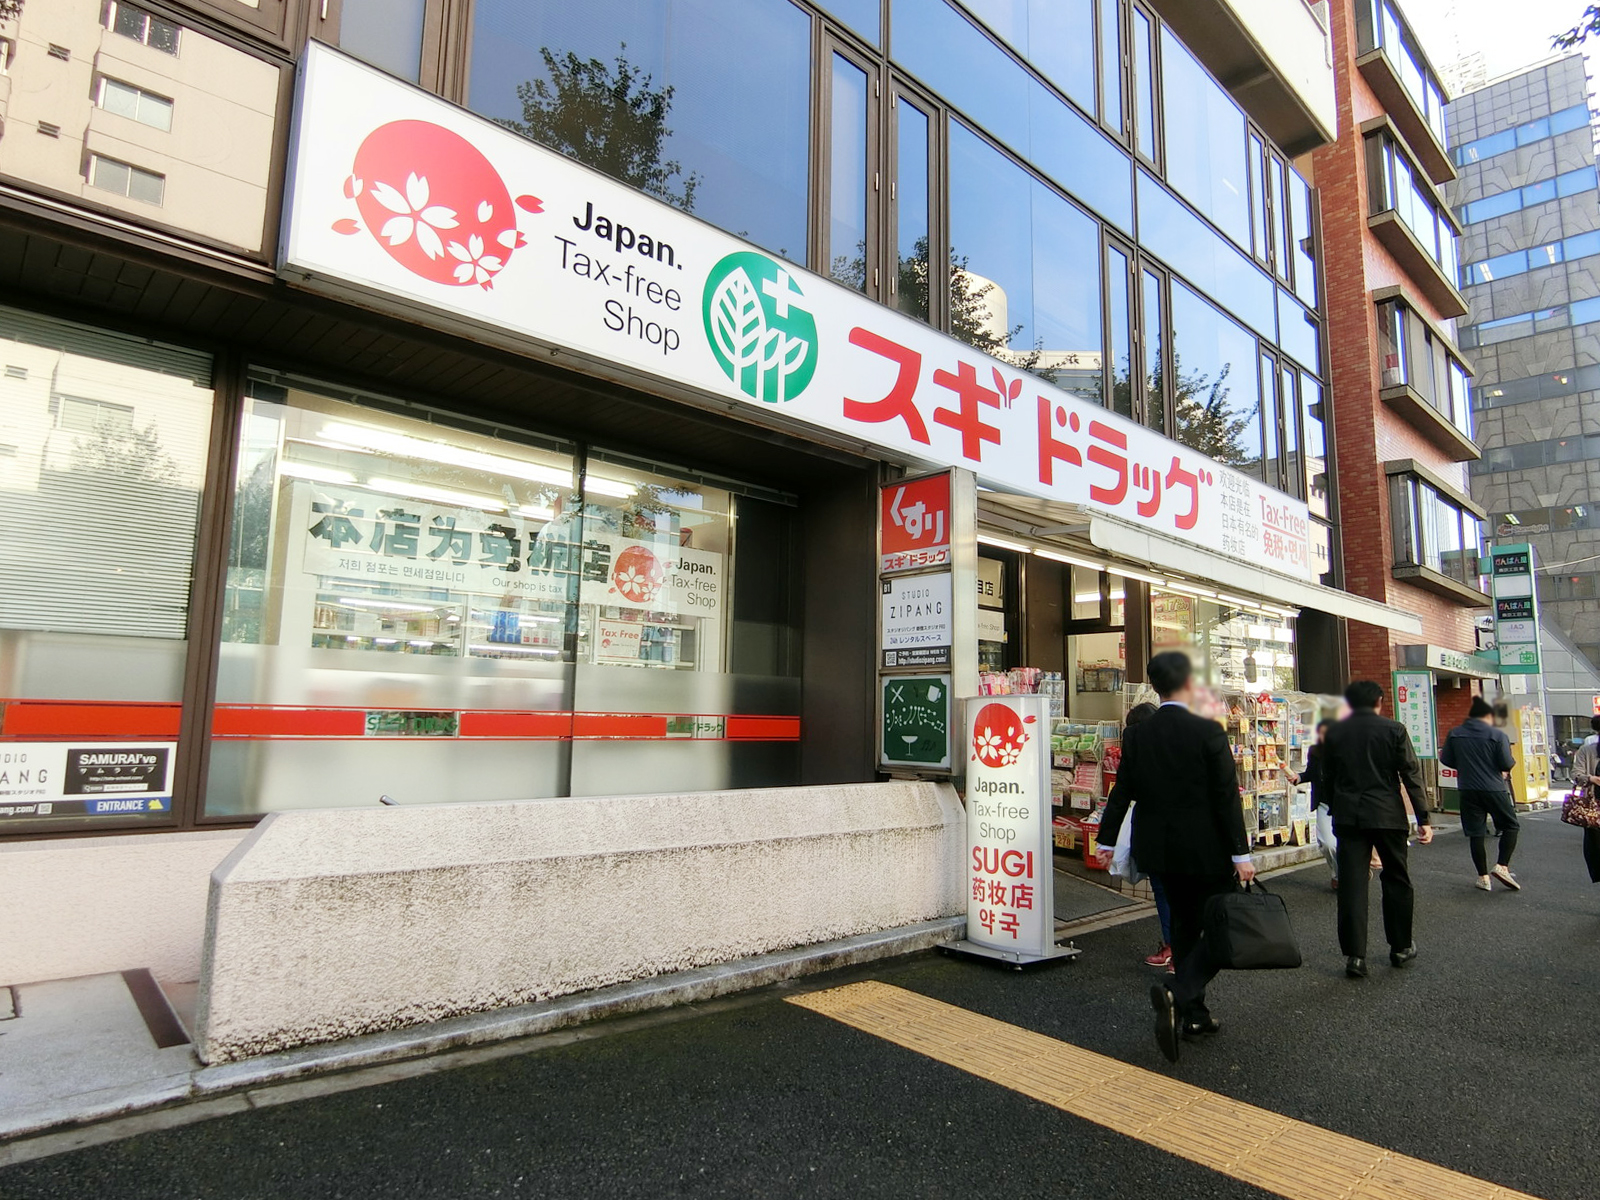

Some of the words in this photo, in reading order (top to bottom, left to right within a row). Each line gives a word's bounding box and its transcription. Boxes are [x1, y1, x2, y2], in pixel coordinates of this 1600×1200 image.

[573, 202, 682, 270] Japan.
[554, 235, 681, 311] Tax-free
[603, 300, 680, 355] Shop
[1220, 469, 1250, 498] 欢迎光临
[1220, 491, 1251, 517] 本店是在
[890, 486, 944, 544] くすり
[1259, 494, 1306, 537] Tax-Free
[1222, 513, 1259, 541] 日本有名的
[338, 558, 361, 571] 저희
[366, 561, 399, 577] 점포는
[403, 565, 465, 583] 면세점입니다
[676, 557, 716, 575] Japan.
[884, 550, 950, 570] スギドラッグ
[492, 577, 510, 588] Our
[513, 580, 537, 592] shop
[539, 582, 546, 592] is
[549, 584, 563, 594] tax
[671, 574, 717, 593] Tax-free
[687, 592, 716, 610] Shop
[901, 588, 930, 601] STUDIO
[890, 601, 942, 619] ZIPANG
[601, 628, 617, 638] Tax
[620, 629, 639, 640] Free
[899, 634, 942, 645] レンタルスペース
[80, 753, 157, 765] SAMURAI've
[974, 776, 1025, 795] Japan.
[96, 799, 145, 812] ENTRANCE
[973, 800, 1029, 820] Tax-free
[979, 821, 1016, 844] Shop
[972, 846, 1033, 879] SUGI
[972, 876, 1033, 911] 药妆店
[979, 908, 1020, 940] 약국
